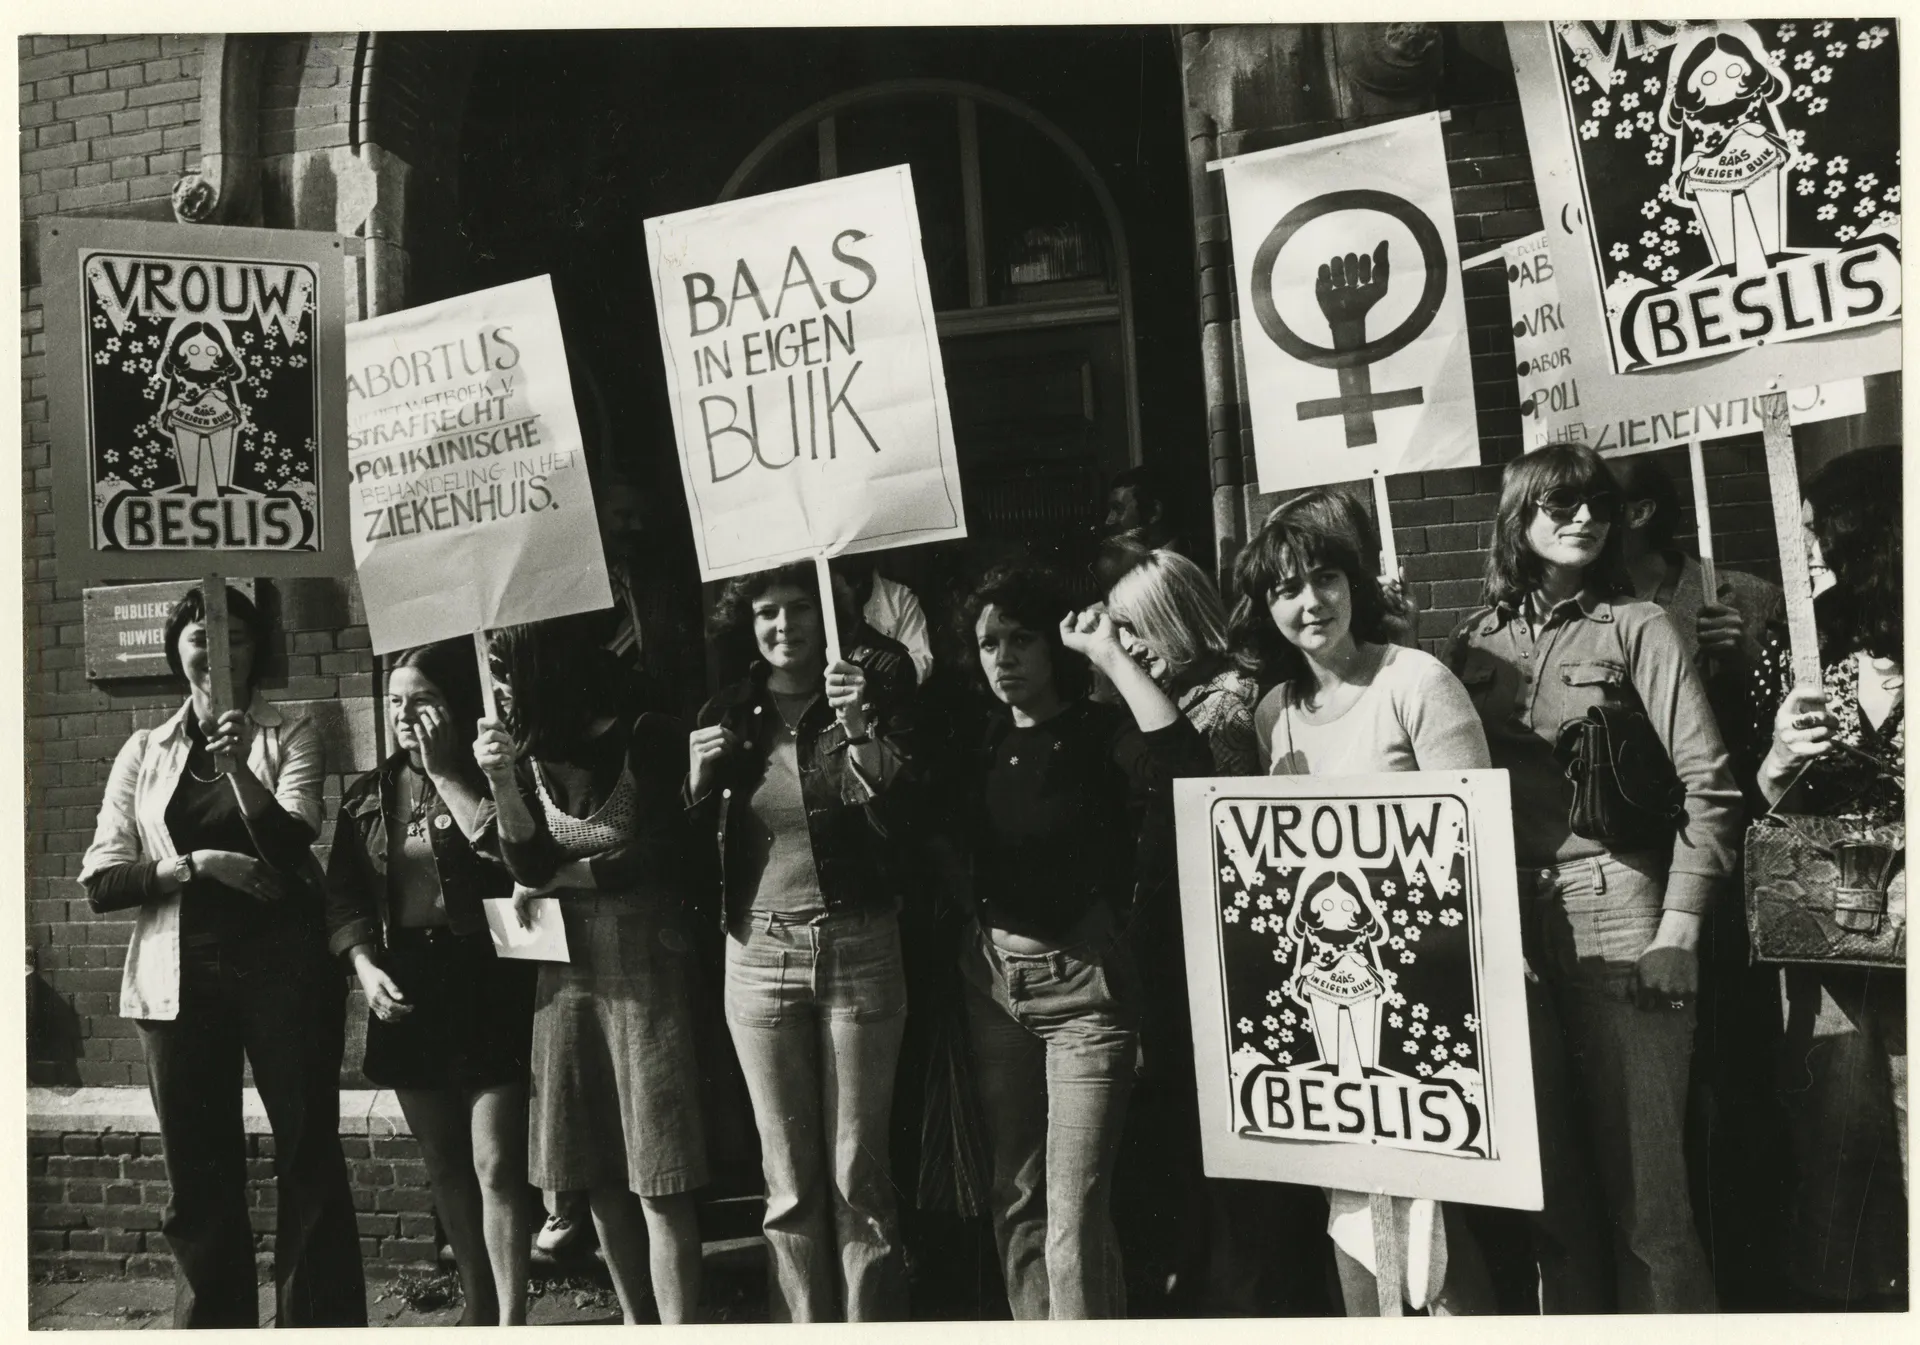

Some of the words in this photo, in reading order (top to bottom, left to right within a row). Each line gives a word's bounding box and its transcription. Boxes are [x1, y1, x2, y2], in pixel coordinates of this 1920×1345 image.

[1694, 167, 1706, 177] IN
[1707, 168, 1742, 178] EIGEN
[1746, 148, 1774, 172] BUIK
[1719, 149, 1751, 166] BAAS
[102, 261, 295, 321] VROUW
[683, 229, 877, 336] BAAS
[1648, 250, 1884, 357] BESLIS
[347, 326, 520, 399] ABORTUS
[694, 340, 732, 386] IN
[742, 310, 855, 376] EIGEN
[348, 393, 514, 450] STRAFRECHT
[699, 361, 881, 483] BUIK
[355, 419, 541, 483] POLIKLINISCHE
[361, 462, 506, 505] BEHANDELING
[513, 458, 535, 478] IN
[540, 450, 577, 474] HET
[128, 500, 291, 547] BESLIS
[364, 475, 560, 542] ZIEKENHUIS.
[114, 602, 169, 620] PUBLIEKE
[1229, 803, 1442, 860] VROUW
[1320, 980, 1348, 995] EIGEN
[1351, 978, 1373, 994] BUIK
[1330, 972, 1355, 984] BAAS
[1266, 1077, 1451, 1142] BESLIS
